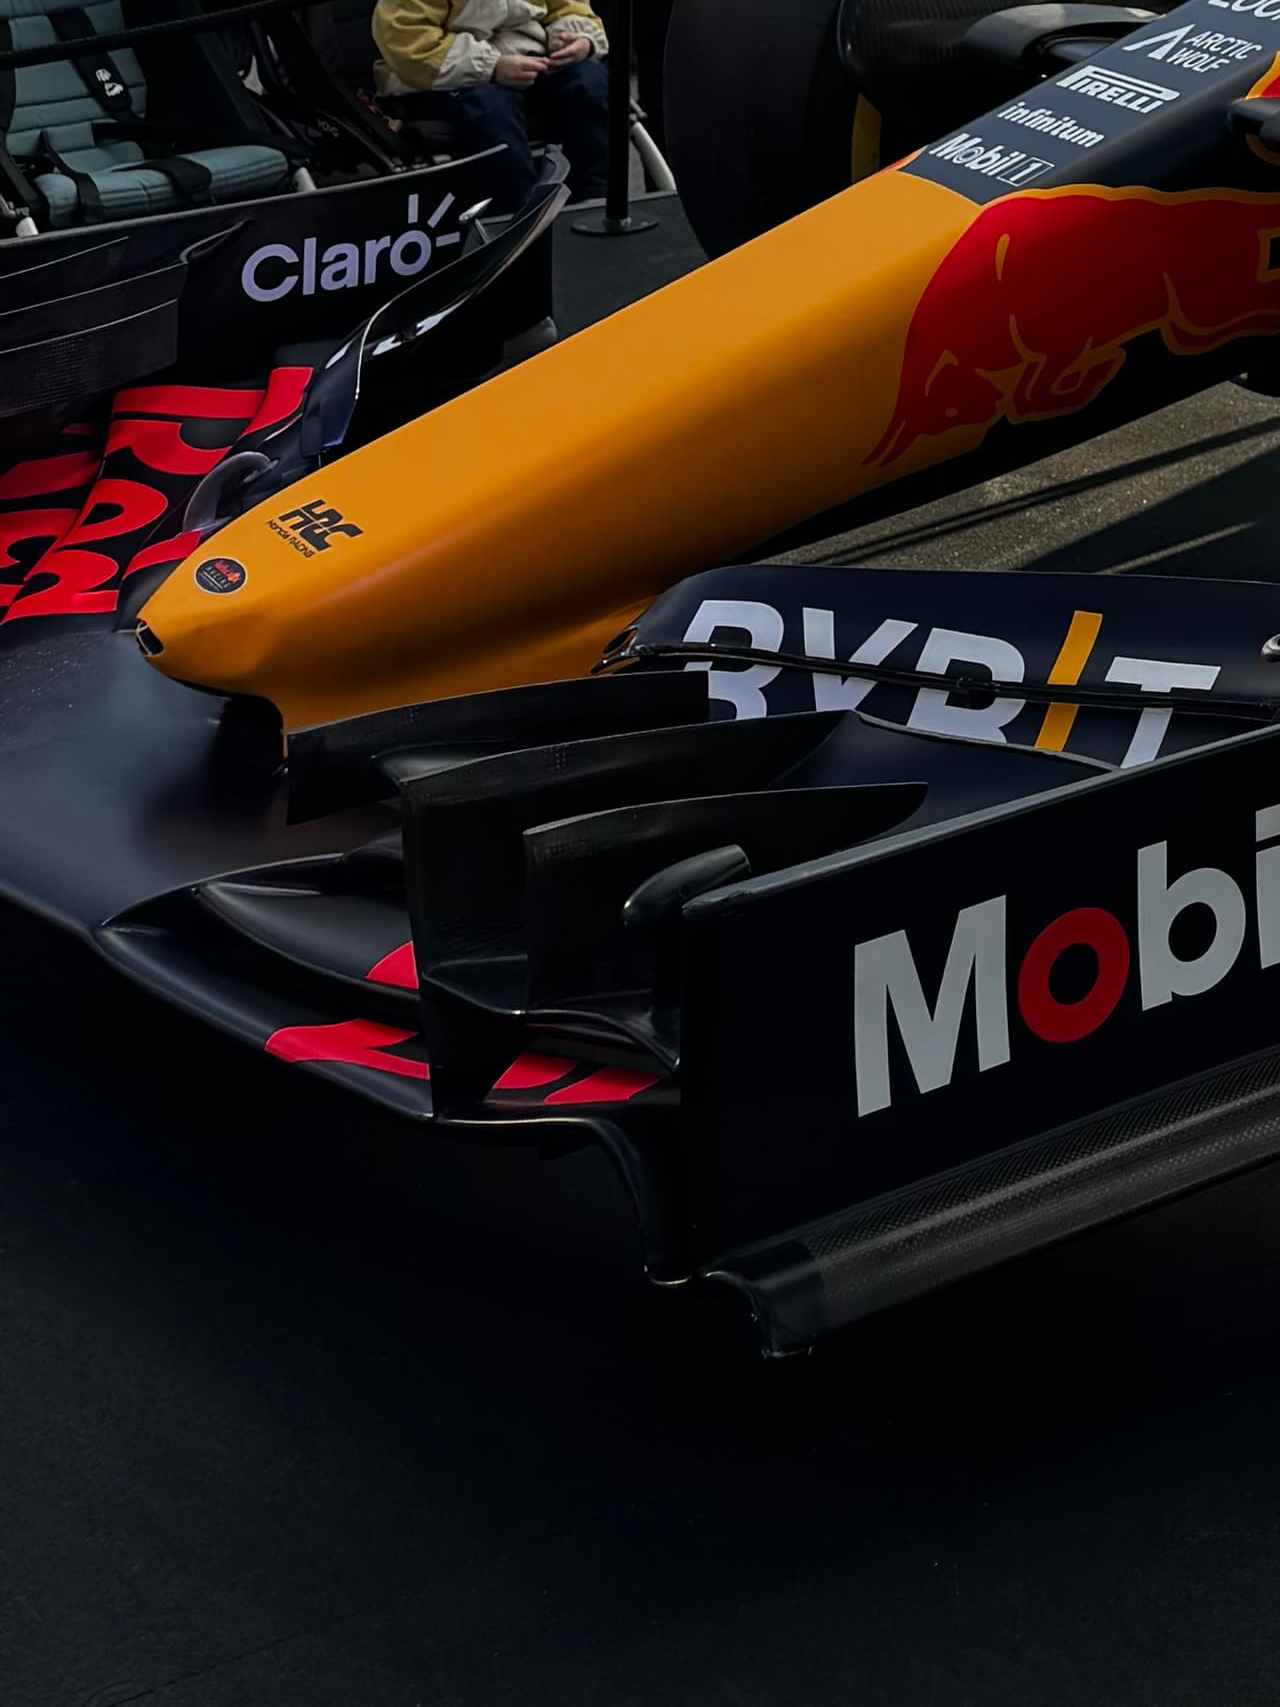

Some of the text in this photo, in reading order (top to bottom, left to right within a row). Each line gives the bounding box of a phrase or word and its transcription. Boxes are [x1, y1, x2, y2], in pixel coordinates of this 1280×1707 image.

[1171, 46, 1229, 74] WOLF
[1185, 30, 1262, 62] ARCTIC
[1057, 65, 1180, 114] PIRELLI
[998, 102, 1104, 148] infinitum
[931, 133, 1020, 180] Mobil
[242, 232, 431, 301] Claro
